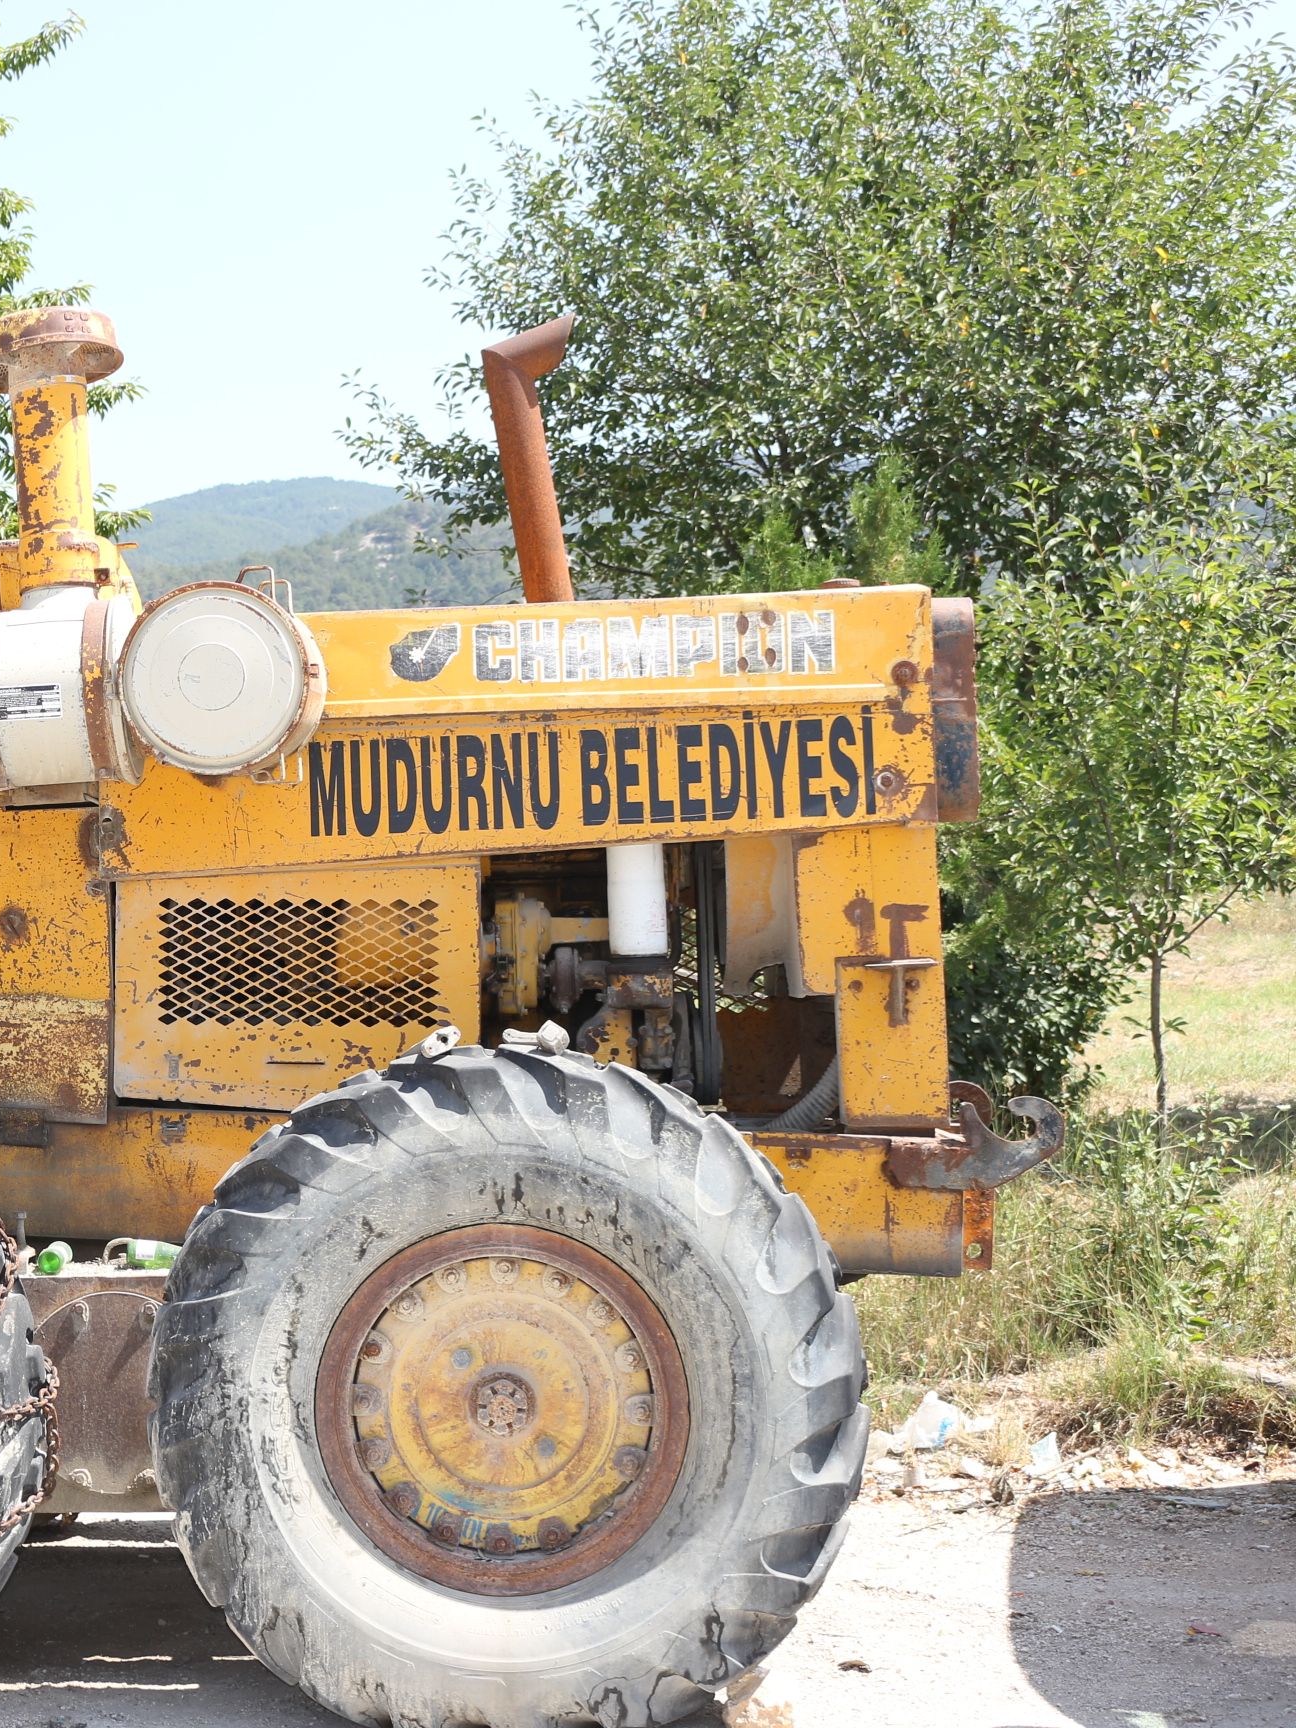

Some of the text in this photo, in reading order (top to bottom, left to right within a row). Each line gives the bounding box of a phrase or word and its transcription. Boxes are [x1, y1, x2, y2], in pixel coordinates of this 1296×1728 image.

[473, 610, 834, 682] CHAMPION
[309, 705, 877, 837] MUDURNU BELEDİYESİ
